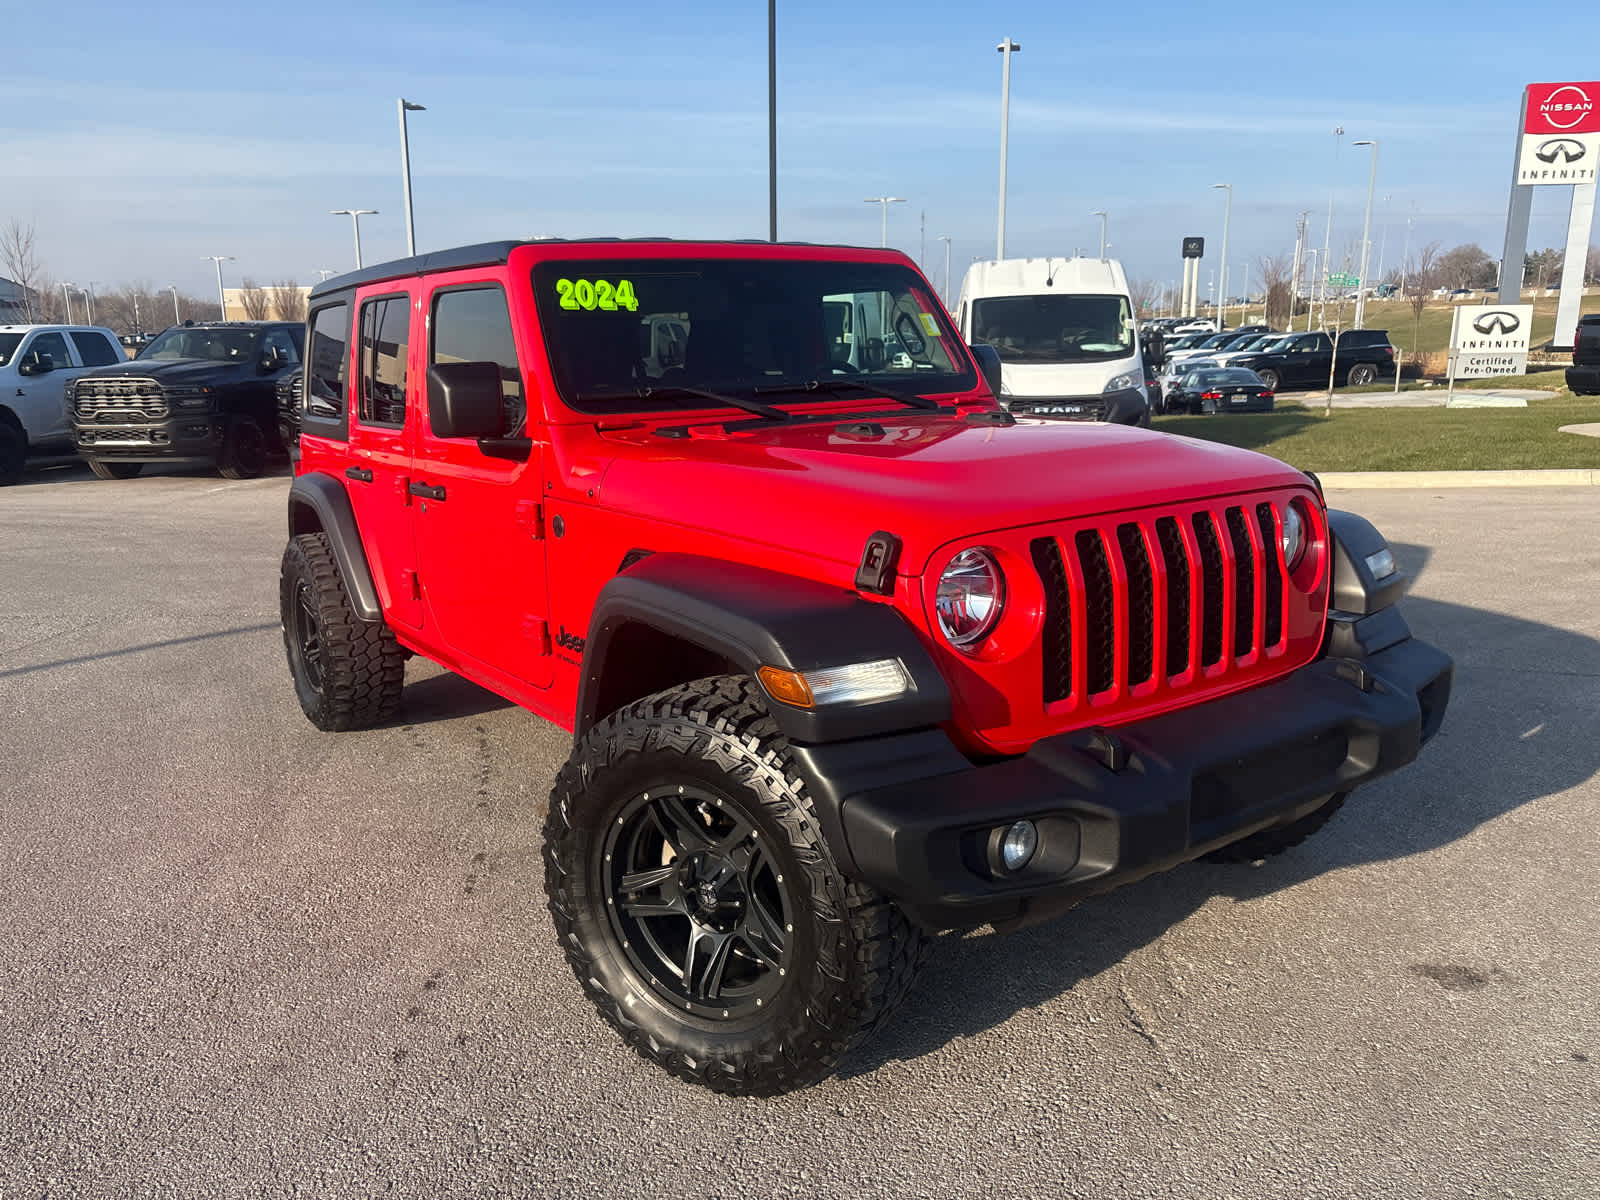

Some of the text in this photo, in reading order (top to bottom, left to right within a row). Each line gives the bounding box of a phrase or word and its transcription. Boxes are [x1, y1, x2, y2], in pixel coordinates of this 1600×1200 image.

[1540, 102, 1593, 112] NISSAN
[1522, 169, 1594, 179] INFINITI
[556, 278, 639, 312] 2024
[1462, 340, 1525, 349] INFINITI
[1470, 357, 1513, 366] Certified
[1464, 365, 1517, 374] Pre-Owned
[1033, 405, 1081, 414] RAM
